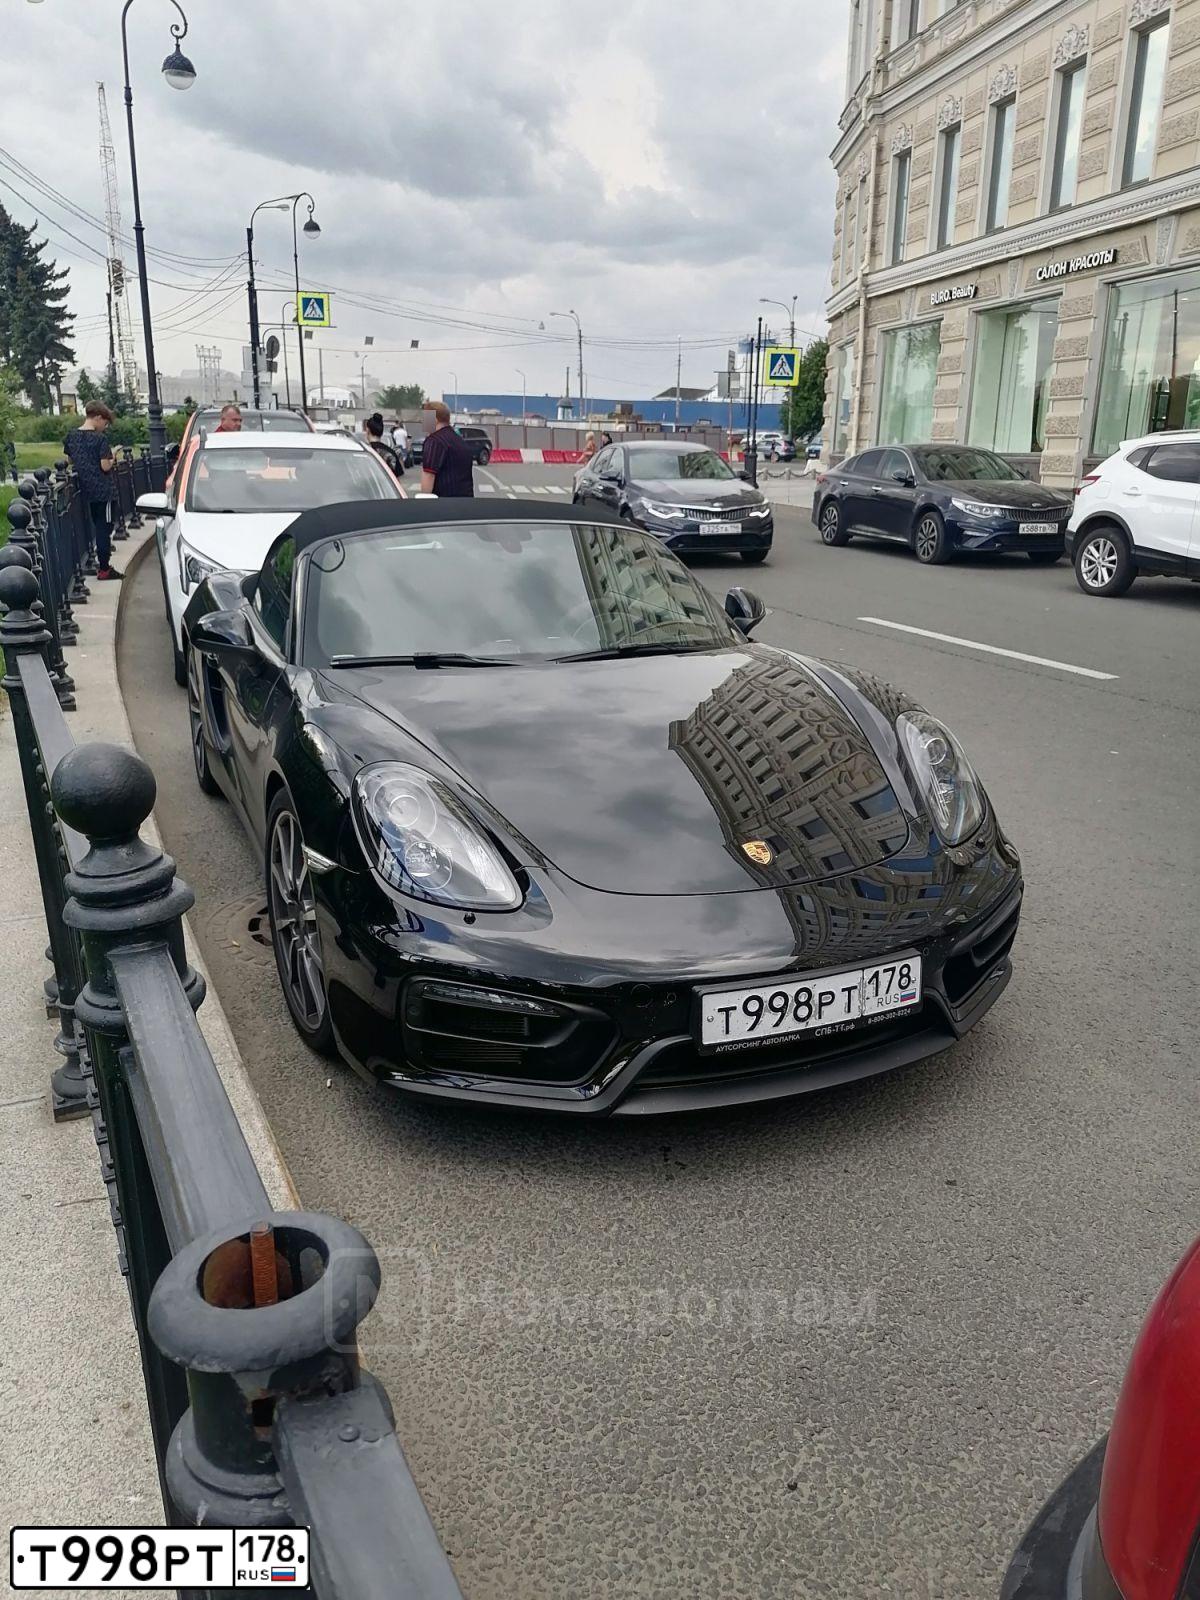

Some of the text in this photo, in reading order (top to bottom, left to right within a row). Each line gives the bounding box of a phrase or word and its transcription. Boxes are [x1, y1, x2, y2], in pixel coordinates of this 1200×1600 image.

[1036, 249, 1115, 281] САЛОН КРАСОТЫ
[951, 284, 976, 299] Beauty
[867, 963, 912, 997] 178
[877, 994, 900, 1007] RUS
[761, 1034, 801, 1046] АВТОПАРКА
